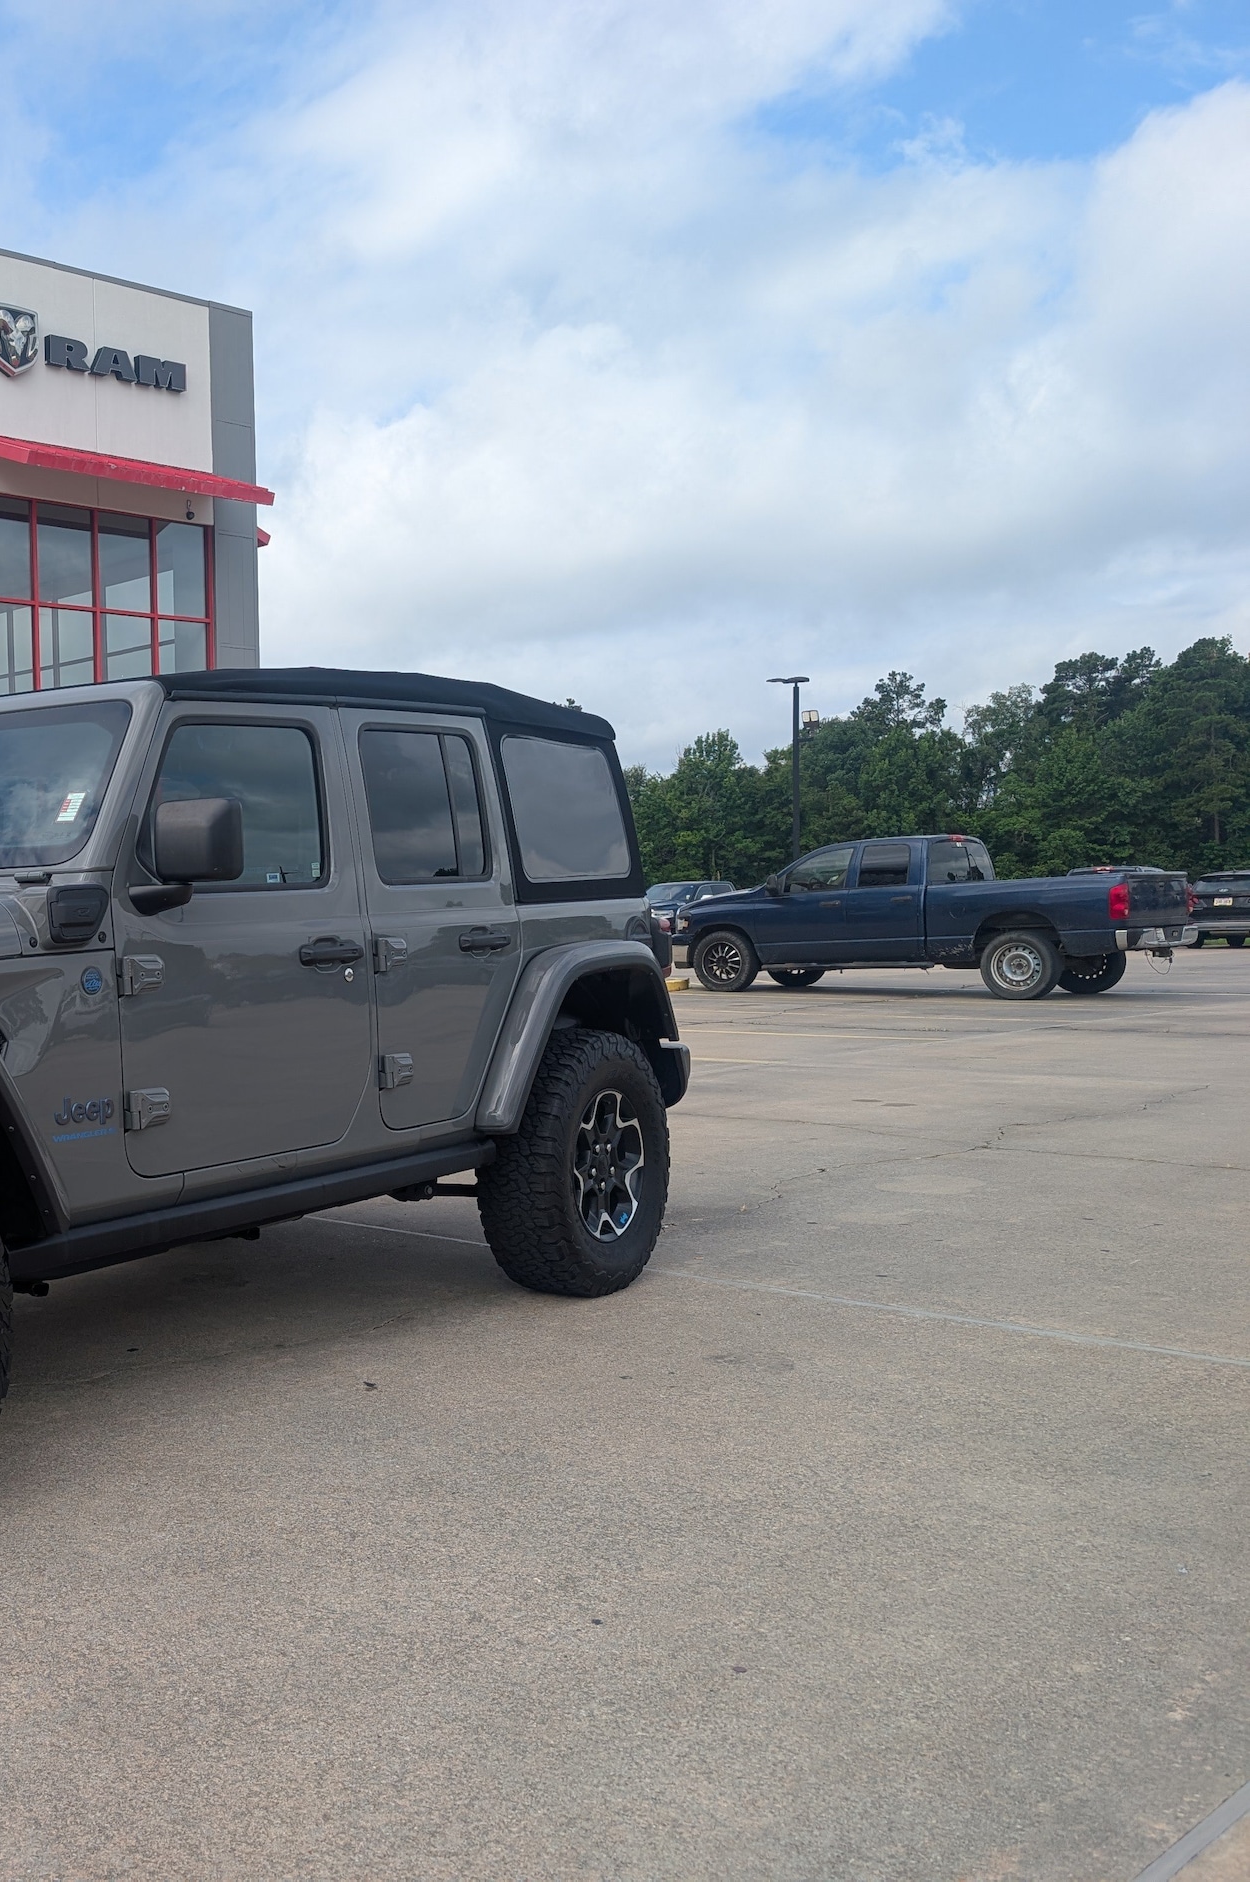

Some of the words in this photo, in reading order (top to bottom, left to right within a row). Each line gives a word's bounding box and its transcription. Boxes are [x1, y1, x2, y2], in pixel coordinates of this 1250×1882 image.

[44, 334, 188, 393] RAM
[54, 1096, 115, 1126] Jeep
[52, 1128, 108, 1143] WRANGLER
